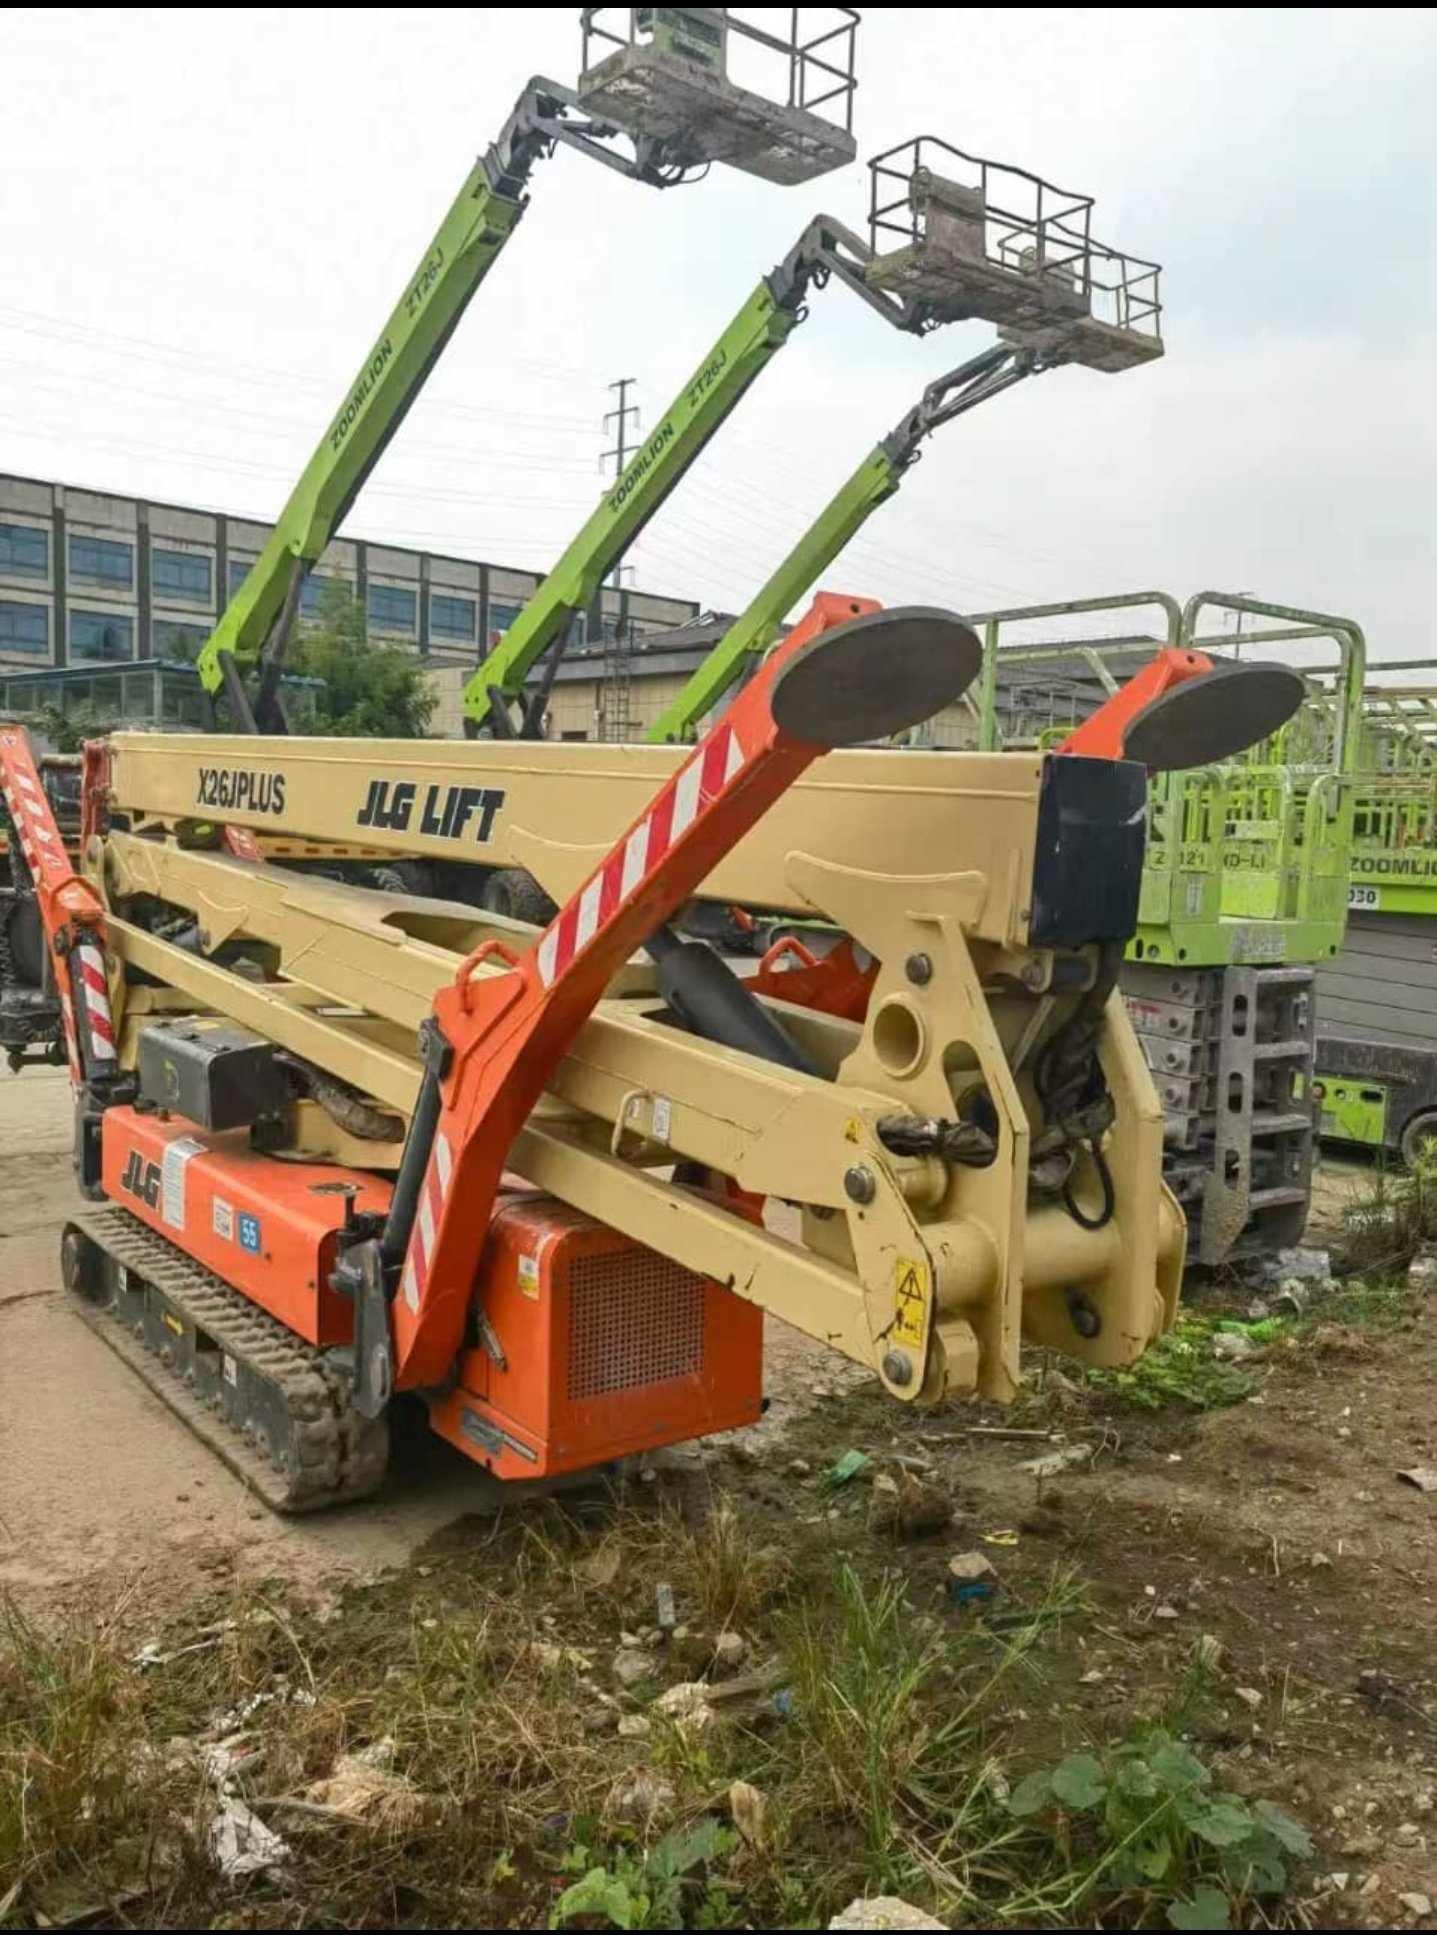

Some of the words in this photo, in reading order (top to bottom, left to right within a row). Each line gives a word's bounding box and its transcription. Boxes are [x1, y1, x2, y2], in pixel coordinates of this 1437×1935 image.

[330, 338, 394, 450] ZOOMLION
[405, 247, 445, 319] ZT26J
[609, 421, 675, 513] ZOOMLION
[687, 349, 727, 407] ZT26J
[197, 768, 286, 815] X26JPLUS
[356, 780, 416, 831] JLG
[420, 785, 505, 842] LIFT
[121, 1149, 162, 1210] JLG
[241, 1216, 257, 1249] 55
